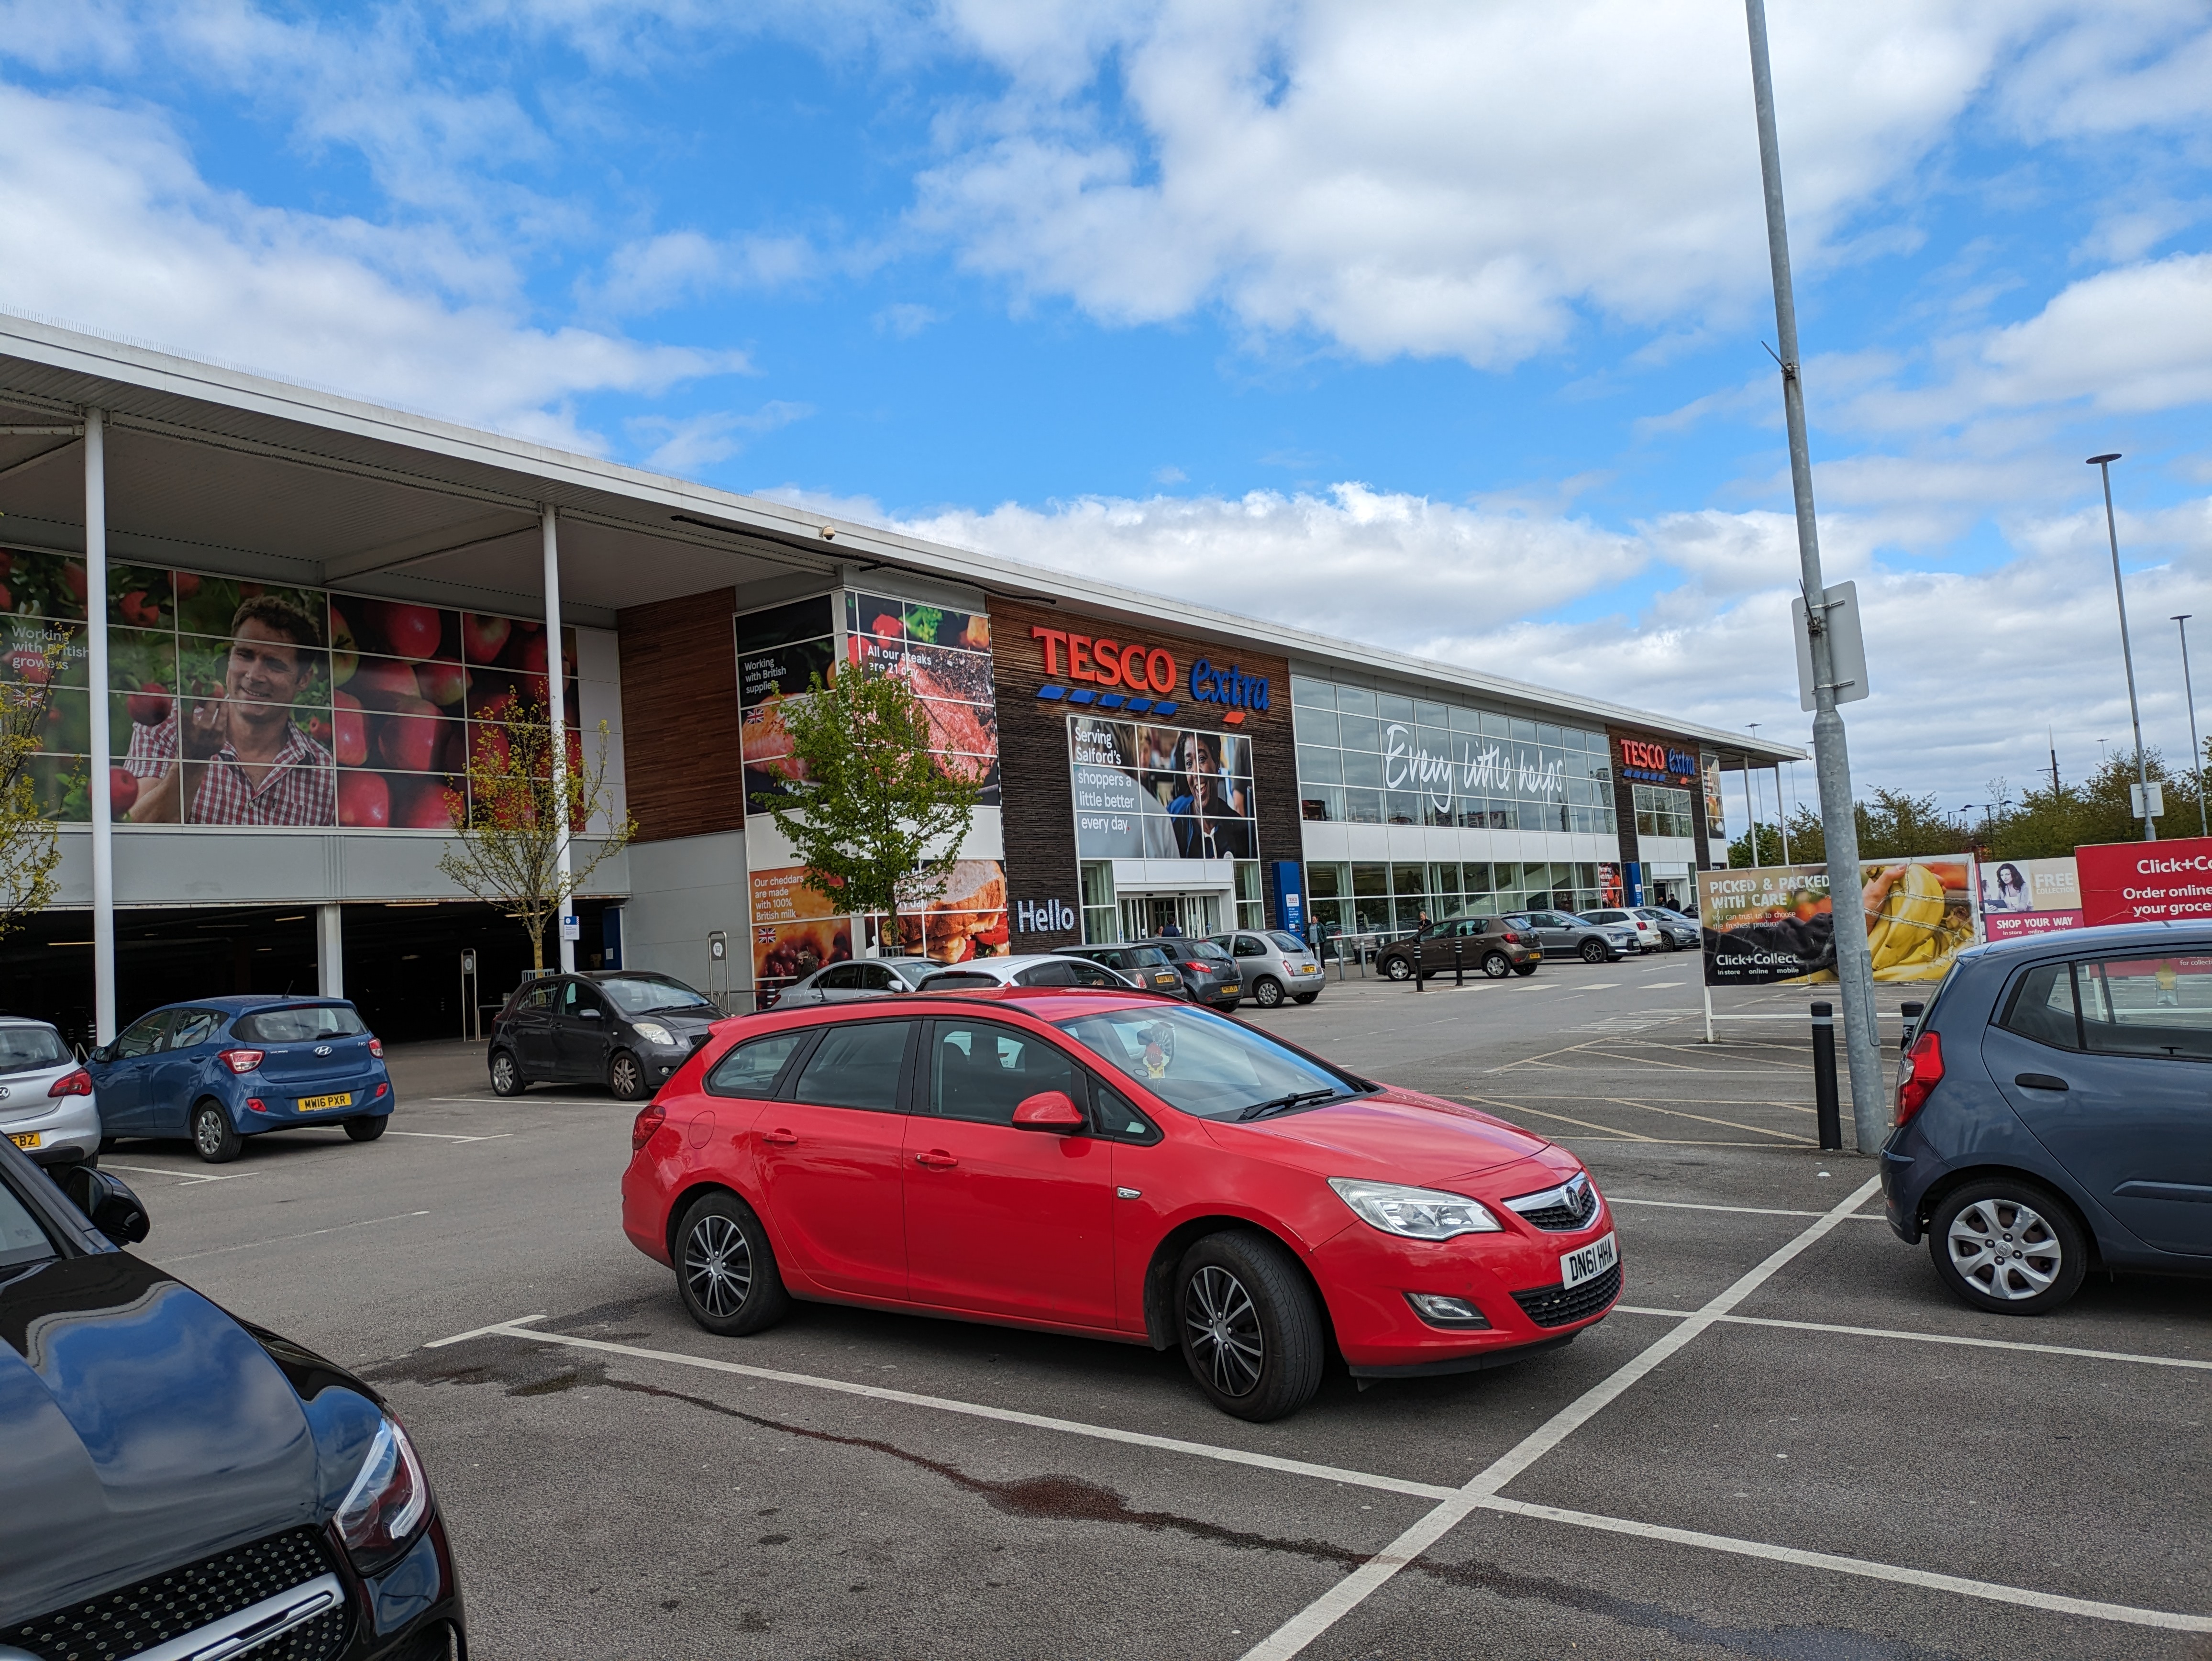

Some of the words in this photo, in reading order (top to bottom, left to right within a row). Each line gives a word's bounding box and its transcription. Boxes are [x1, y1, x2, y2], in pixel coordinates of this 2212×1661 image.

[12, 641, 43, 653] with
[867, 645, 880, 657] All
[882, 650, 899, 660] our
[901, 652, 932, 665] steaks
[744, 658, 774, 671] Working
[888, 662, 898, 675] 21
[1031, 626, 1177, 693] TESCO
[1189, 658, 1271, 710] extra
[745, 671, 761, 683] with
[763, 666, 786, 679] British
[1075, 726, 1112, 749] Serving
[1076, 746, 1121, 765] Salford's
[1618, 739, 1665, 770] TESCO
[1667, 747, 1696, 775] extra
[1385, 724, 1452, 813] Every
[1463, 741, 1510, 792] little
[1519, 749, 1563, 807] helps
[1078, 769, 1124, 789] shoppers
[1126, 775, 1132, 787] a
[1079, 791, 1102, 807] little
[1104, 792, 1135, 808] better
[1081, 817, 1109, 833] every
[754, 878, 768, 887] Our
[770, 875, 804, 886] cheddars
[1710, 880, 1757, 894] PICKED
[1763, 878, 1773, 890] &
[1779, 875, 1830, 890] PACKED
[2035, 873, 2074, 888] FREE
[768, 887, 789, 897] made
[2123, 886, 2166, 899] Order
[755, 899, 771, 909] with
[773, 897, 793, 908] 100%
[1711, 895, 1745, 909] WITH
[1752, 893, 1787, 907] CARE
[756, 910, 779, 920] British
[1017, 899, 1074, 932] Hello
[2133, 905, 2167, 917] your
[2169, 902, 2212, 915] groce
[1753, 921, 1779, 930] produce
[1996, 919, 2021, 929] SHOP
[2024, 918, 2050, 928] YOUR
[2053, 917, 2073, 926] WAY
[1716, 953, 1800, 965] Click+Collect
[304, 1100, 326, 1109] MW16
[328, 1095, 346, 1106] PXR
[1569, 1247, 1598, 1282] DN61
[1597, 1238, 1614, 1269] HHA
